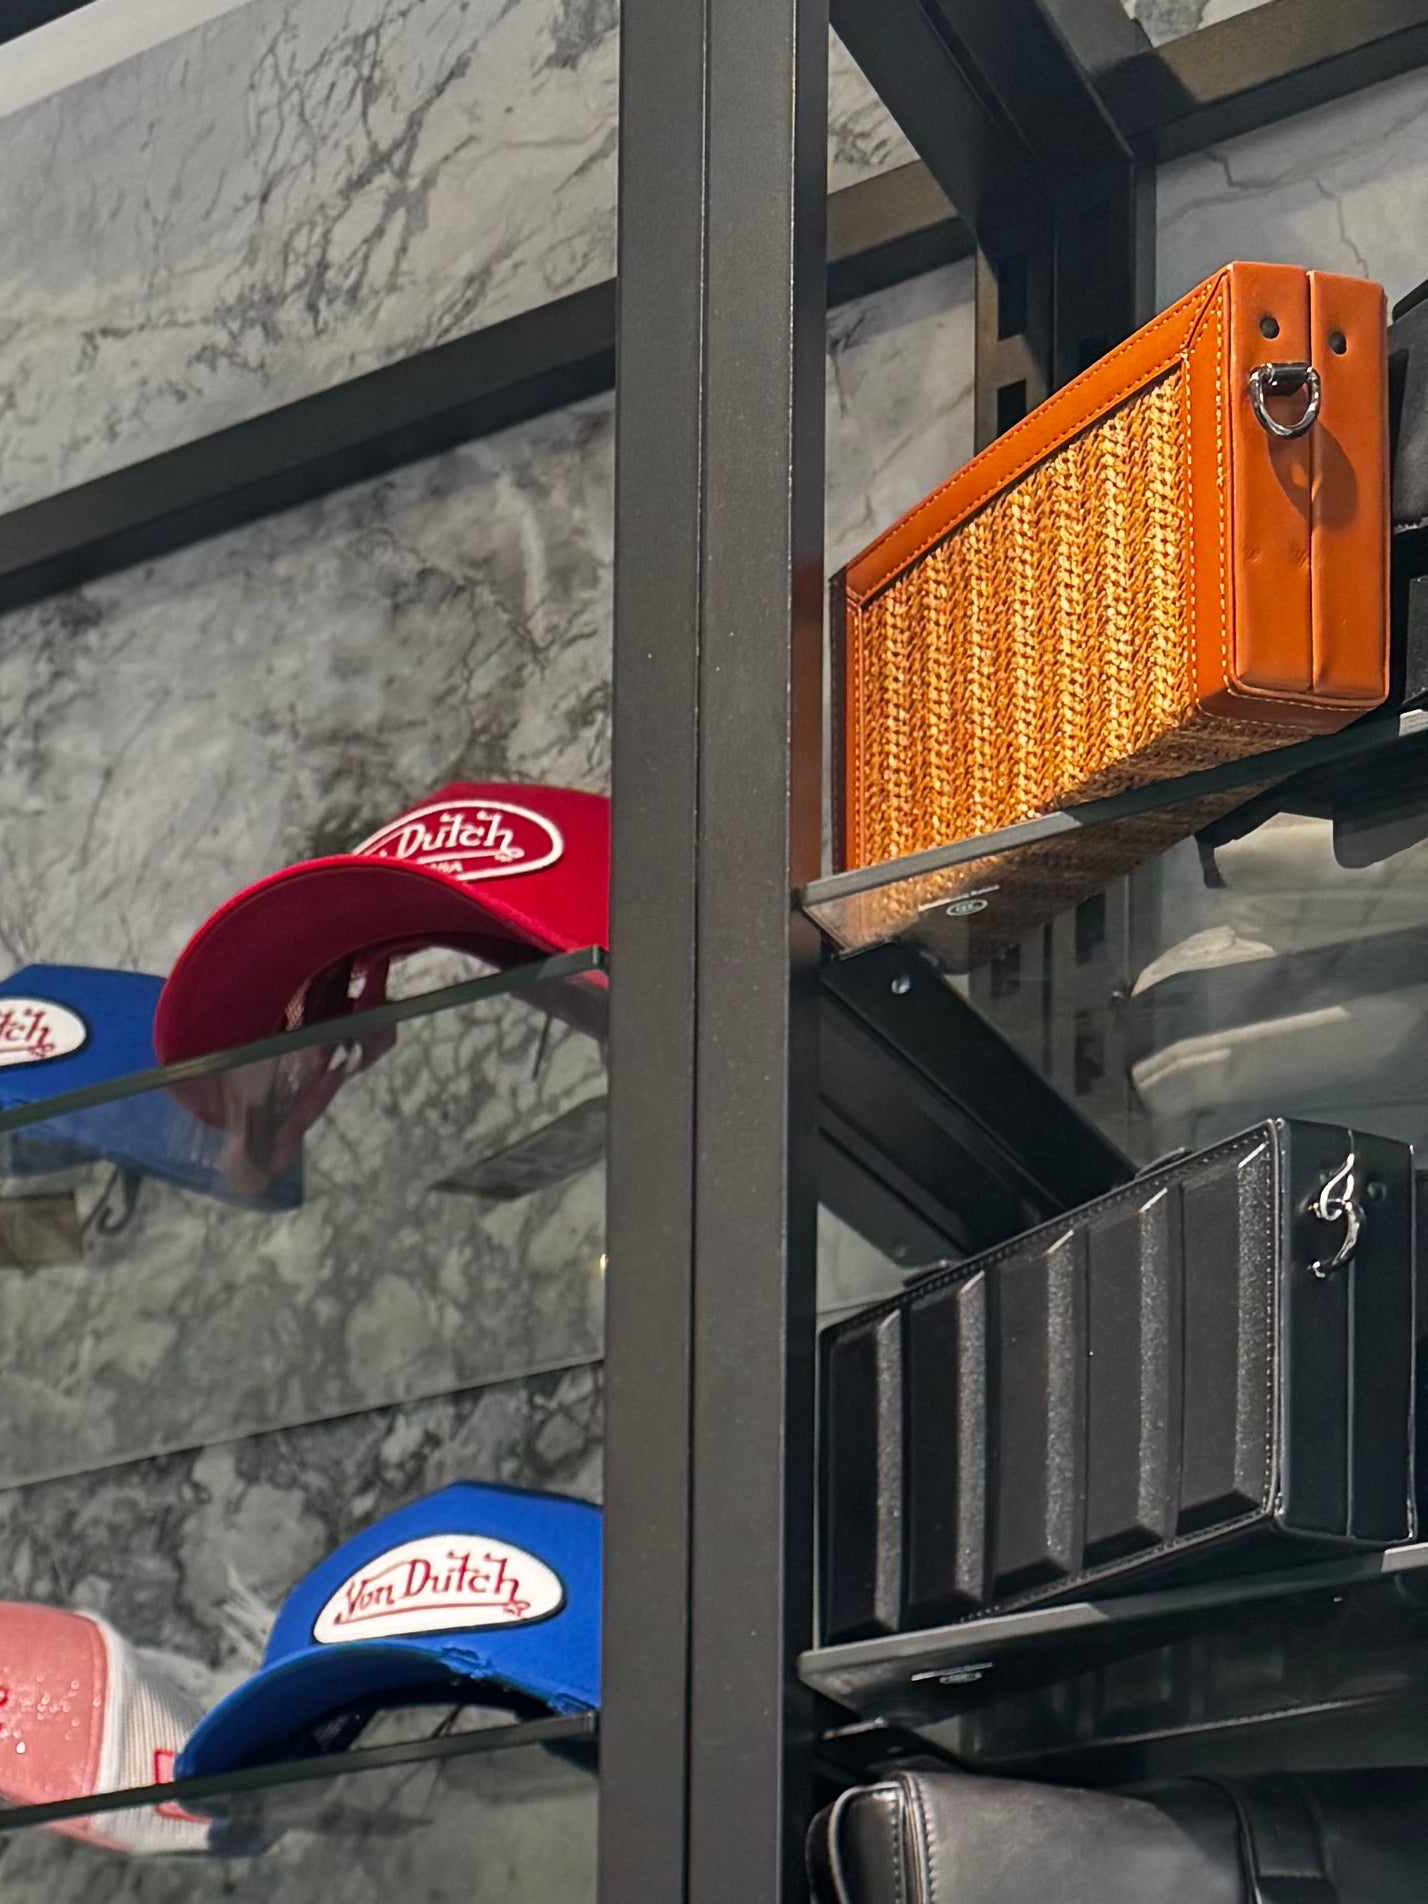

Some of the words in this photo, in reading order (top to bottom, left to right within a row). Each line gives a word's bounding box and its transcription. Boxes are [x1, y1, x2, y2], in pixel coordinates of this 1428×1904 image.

[395, 809, 526, 860] Dutch
[344, 1576, 395, 1617] Von
[404, 1550, 531, 1616] Dutch
